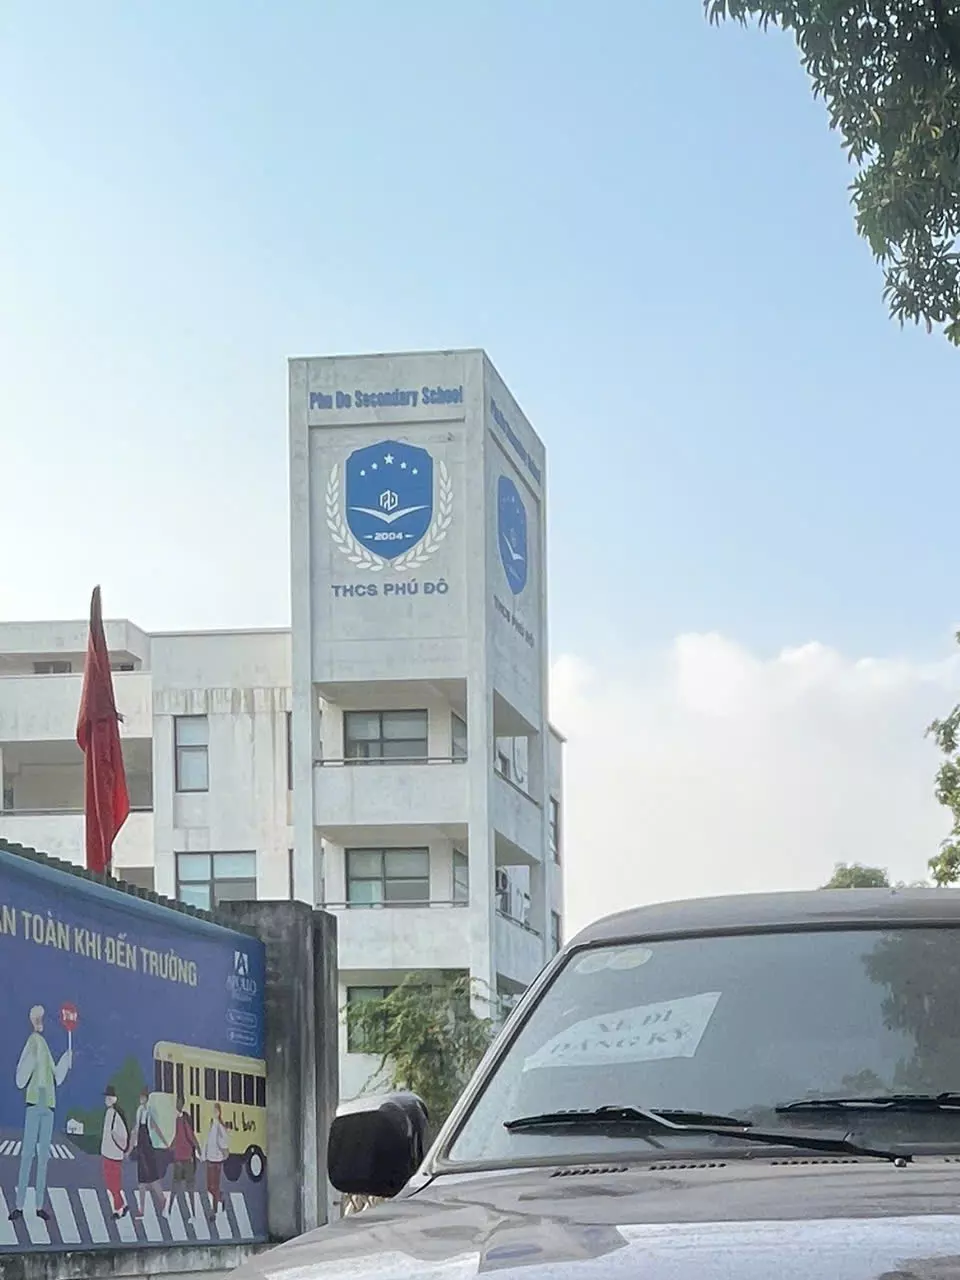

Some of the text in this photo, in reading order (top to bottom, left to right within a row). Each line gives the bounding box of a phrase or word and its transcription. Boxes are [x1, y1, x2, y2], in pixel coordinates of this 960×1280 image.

[354, 388, 419, 408] Secondary
[421, 384, 464, 405] School
[374, 531, 404, 541] 2004
[331, 577, 449, 597] THCS PHÚ ĐÔ
[21, 909, 71, 952] TOÀN
[74, 927, 101, 960] KHI
[104, 931, 138, 972] ĐẾN
